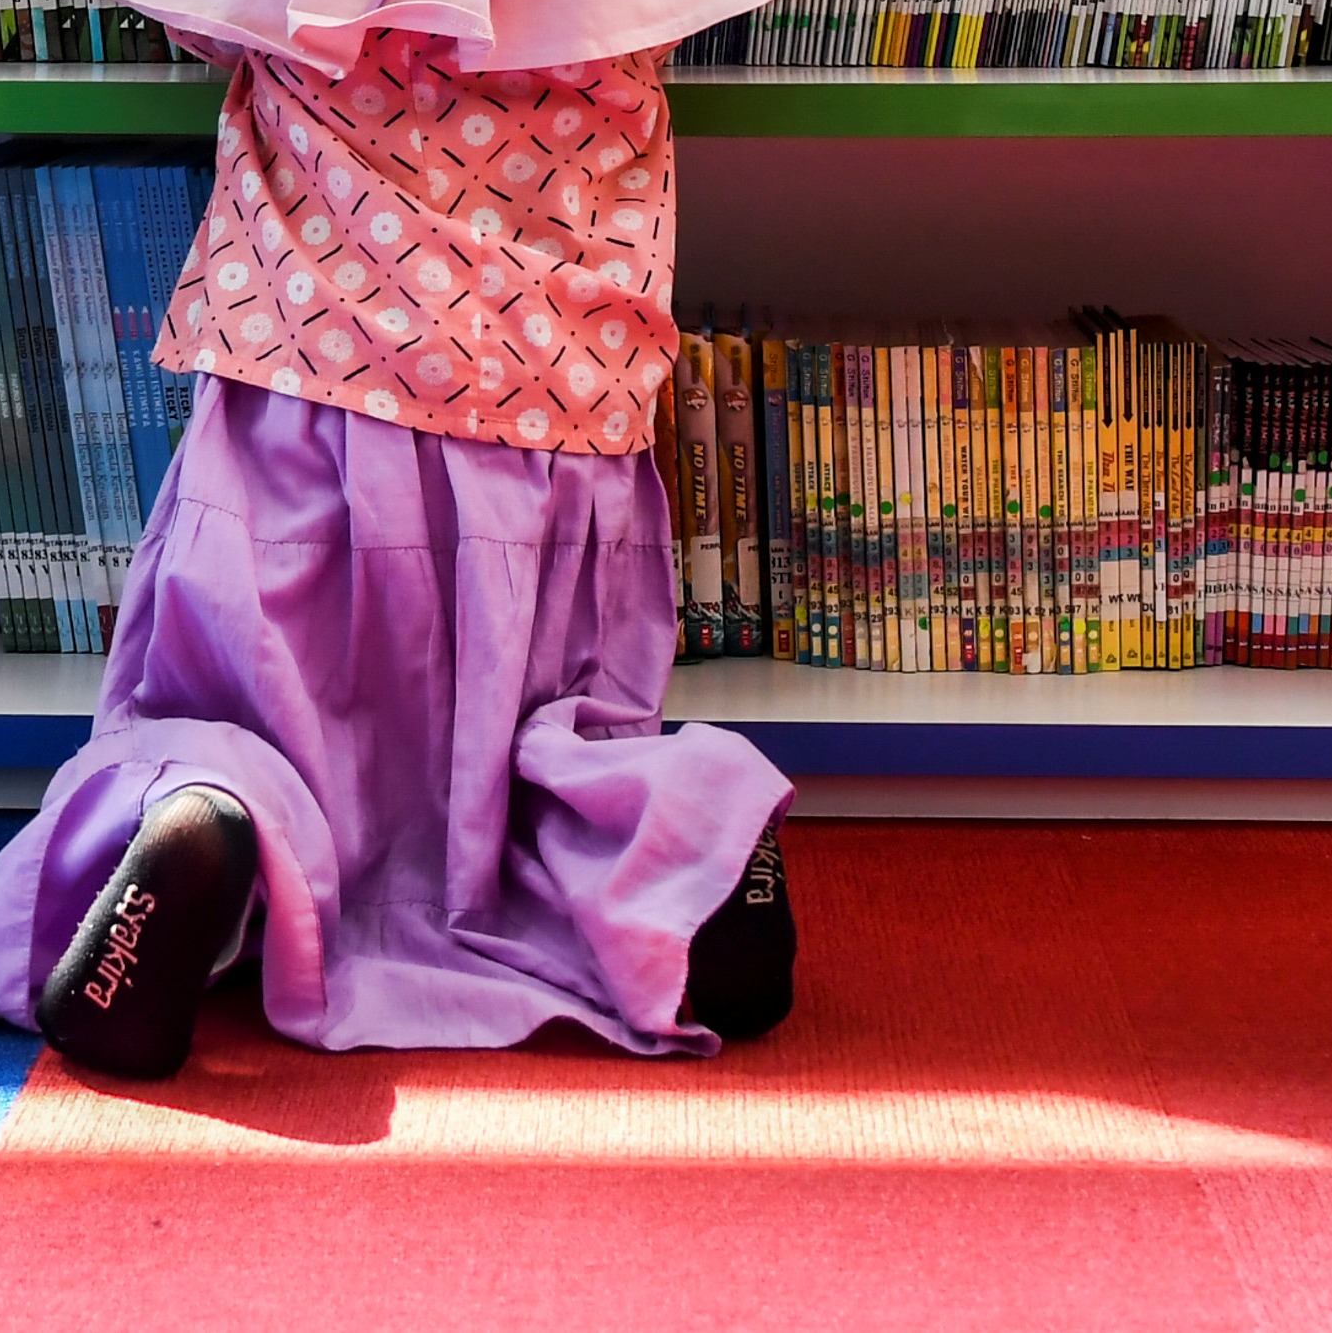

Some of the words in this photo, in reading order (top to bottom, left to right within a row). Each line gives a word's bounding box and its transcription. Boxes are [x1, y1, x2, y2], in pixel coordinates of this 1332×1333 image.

[165, 386, 179, 422] RICKY
[693, 444, 704, 468] NO
[733, 444, 745, 469] NO
[695, 474, 708, 519] TIME
[734, 474, 747, 520] TIME
[746, 823, 786, 905] akira
[84, 883, 158, 1009] Syakira
